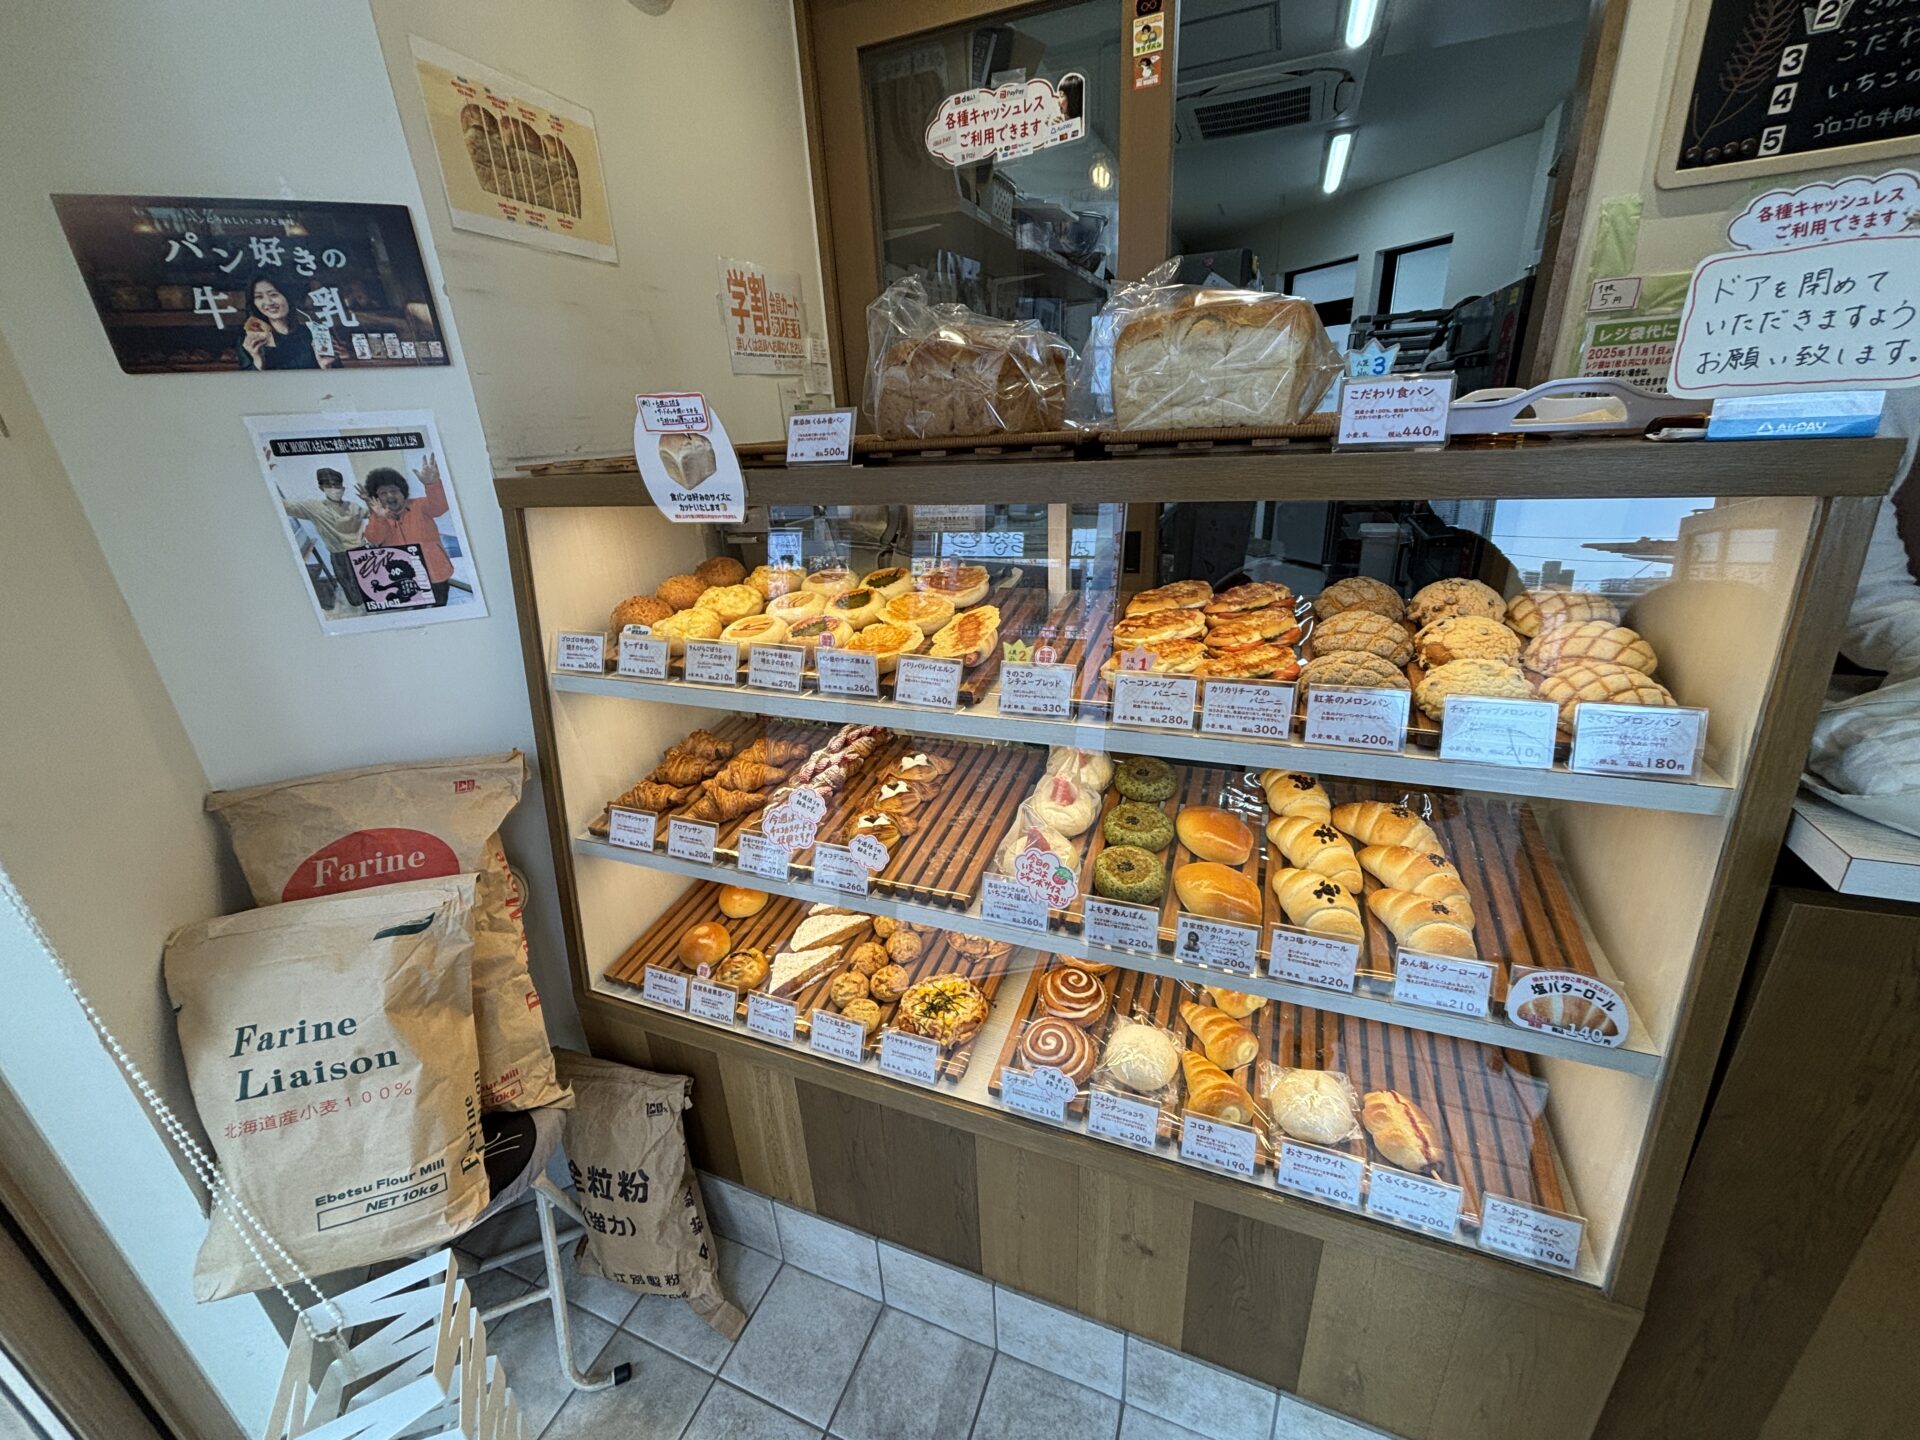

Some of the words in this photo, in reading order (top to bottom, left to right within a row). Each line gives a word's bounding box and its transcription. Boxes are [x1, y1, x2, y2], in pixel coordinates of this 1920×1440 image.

[1817, 0, 1840, 25] 2
[1782, 49, 1803, 72] 3
[1771, 87, 1793, 110] 4
[945, 96, 1045, 130] 各種キャッシュレス
[960, 118, 1041, 148] ご利用できます
[1762, 129, 1784, 151] 5
[1757, 187, 1904, 223] 各種キャッシュレス
[1775, 210, 1897, 240] ご利用できます
[165, 232, 346, 276] パン好きの
[1715, 268, 1889, 303] ドアを閉めて
[193, 286, 237, 329] 牛
[308, 287, 360, 327] 乳
[727, 269, 771, 336] 学割
[1600, 293, 1622, 306] 5円
[1706, 300, 1916, 335] いただきますよう
[1372, 356, 1385, 375] 3
[1697, 339, 1917, 374] お願い致します。
[1350, 387, 1435, 400] こだわり食パン
[1388, 426, 1439, 438] 税込440円
[1019, 651, 1026, 661] 2
[1139, 658, 1147, 671] 1
[1006, 670, 1033, 678] きのこの
[1007, 677, 1061, 687] シチューブレッド
[1120, 679, 1176, 688] ベーコンエッグ
[1153, 690, 1188, 698] パニーニ
[1210, 685, 1270, 696] カリカリチーズの
[1314, 694, 1391, 708] 紅茶のメロンパン
[1348, 734, 1393, 746] 税込200円
[1628, 757, 1684, 770] 税込180円
[313, 850, 426, 889] Farine
[1022, 863, 1048, 878] いちごは
[1027, 853, 1050, 870] 今日の
[1020, 873, 1065, 893] ジャンボサイズ
[1209, 934, 1250, 947] クリームパン
[1277, 934, 1349, 953] チョコ塩バターロール
[1400, 958, 1488, 979] あん塩バターロール
[1531, 980, 1616, 1012] 塩バターロール
[229, 1016, 357, 1058] Farine
[234, 1050, 400, 1102] Liaison
[500, 1067, 519, 1083] Mill
[1095, 1100, 1145, 1119] フォンダンショコラ
[460, 1094, 482, 1175] Farine
[1189, 1121, 1214, 1133] コロネ
[1285, 1146, 1347, 1169] おさつホワイト
[315, 1183, 373, 1207] Ebetsu
[376, 1172, 416, 1191] Flour
[419, 1158, 445, 1176] Mill
[568, 1160, 650, 1203] 全粒粉
[1377, 1173, 1448, 1198] くるくるフランク
[365, 1194, 399, 1213] NET
[402, 1181, 439, 1202] 10kg
[582, 1205, 637, 1236] (強力)
[1491, 1203, 1528, 1219] どうぶつ
[1507, 1217, 1563, 1237] クリームパン
